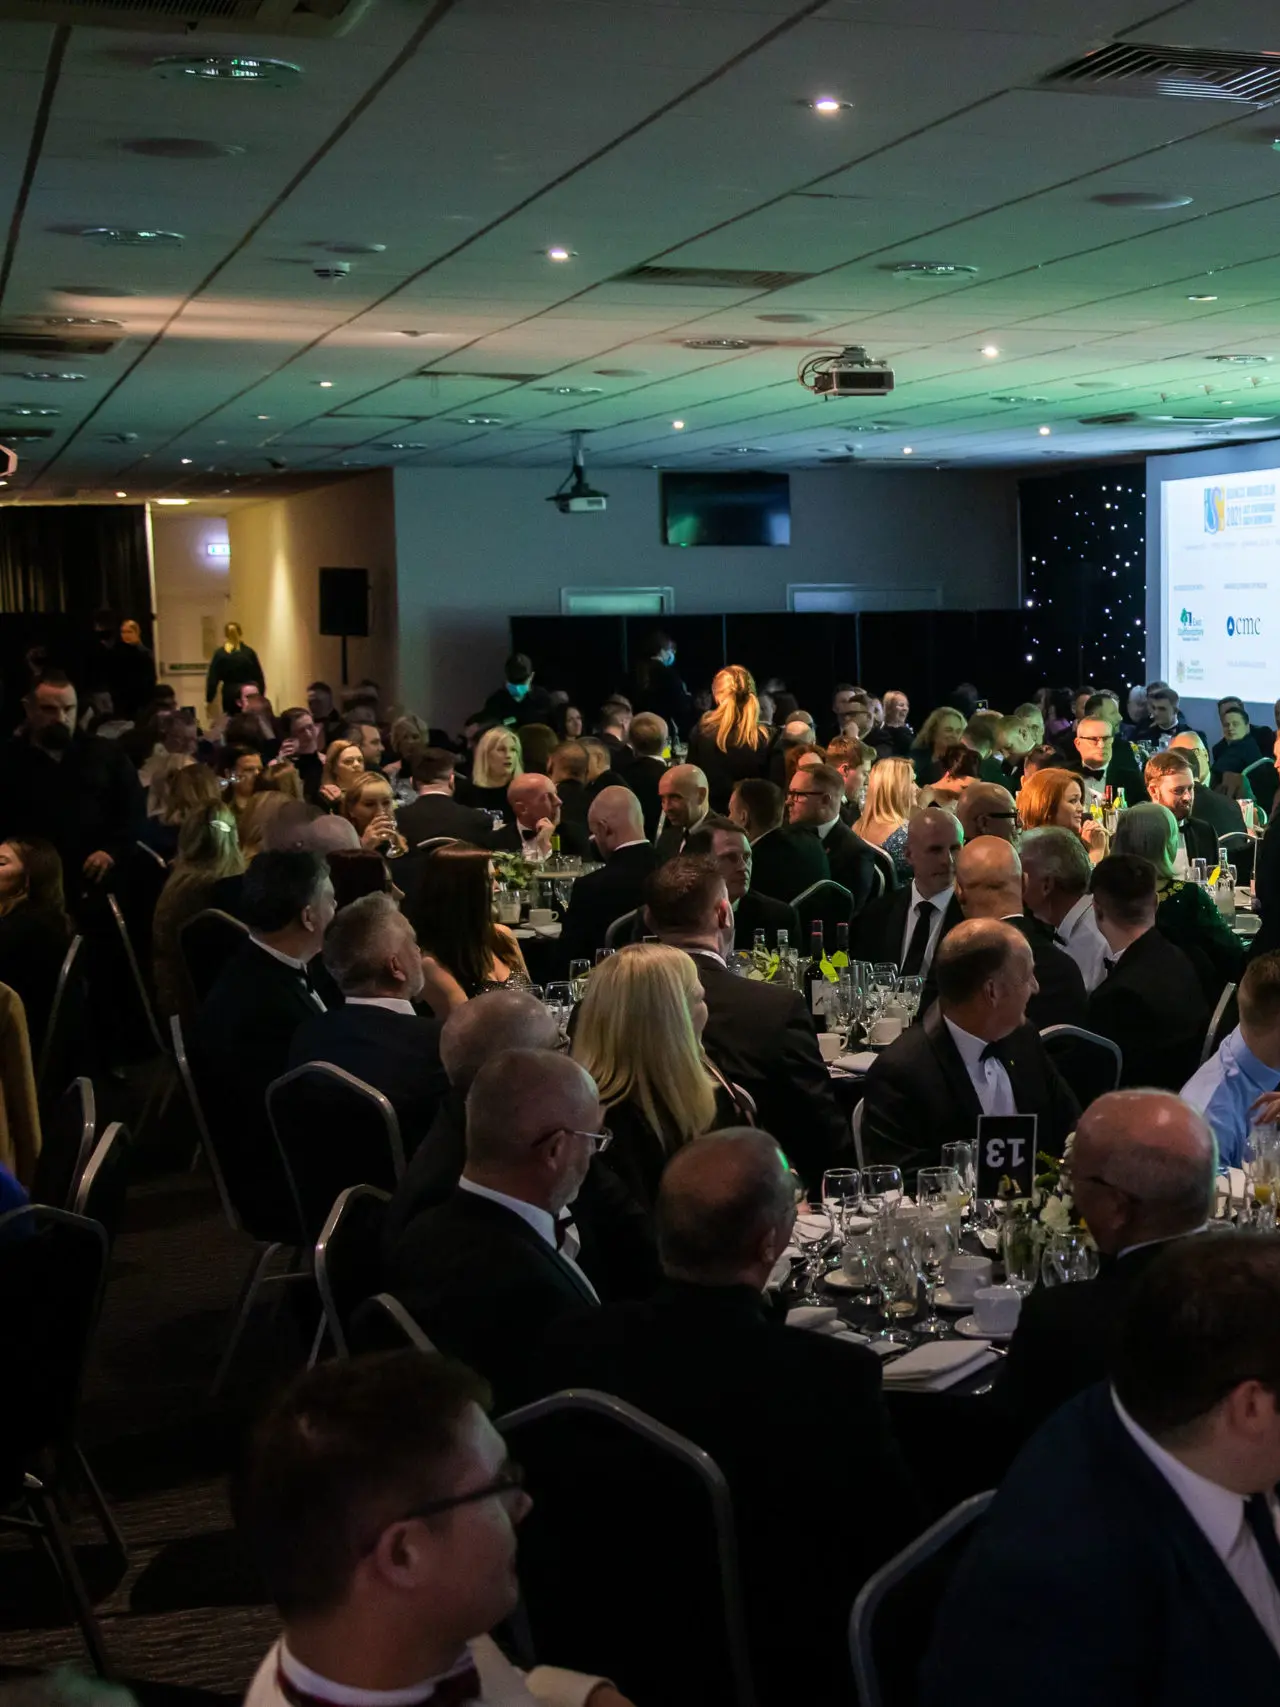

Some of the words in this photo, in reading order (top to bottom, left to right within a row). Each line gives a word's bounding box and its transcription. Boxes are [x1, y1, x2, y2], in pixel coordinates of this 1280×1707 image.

[1226, 506, 1243, 527] 2021
[1236, 617, 1261, 636] cmc
[986, 1138, 1026, 1168] 13
